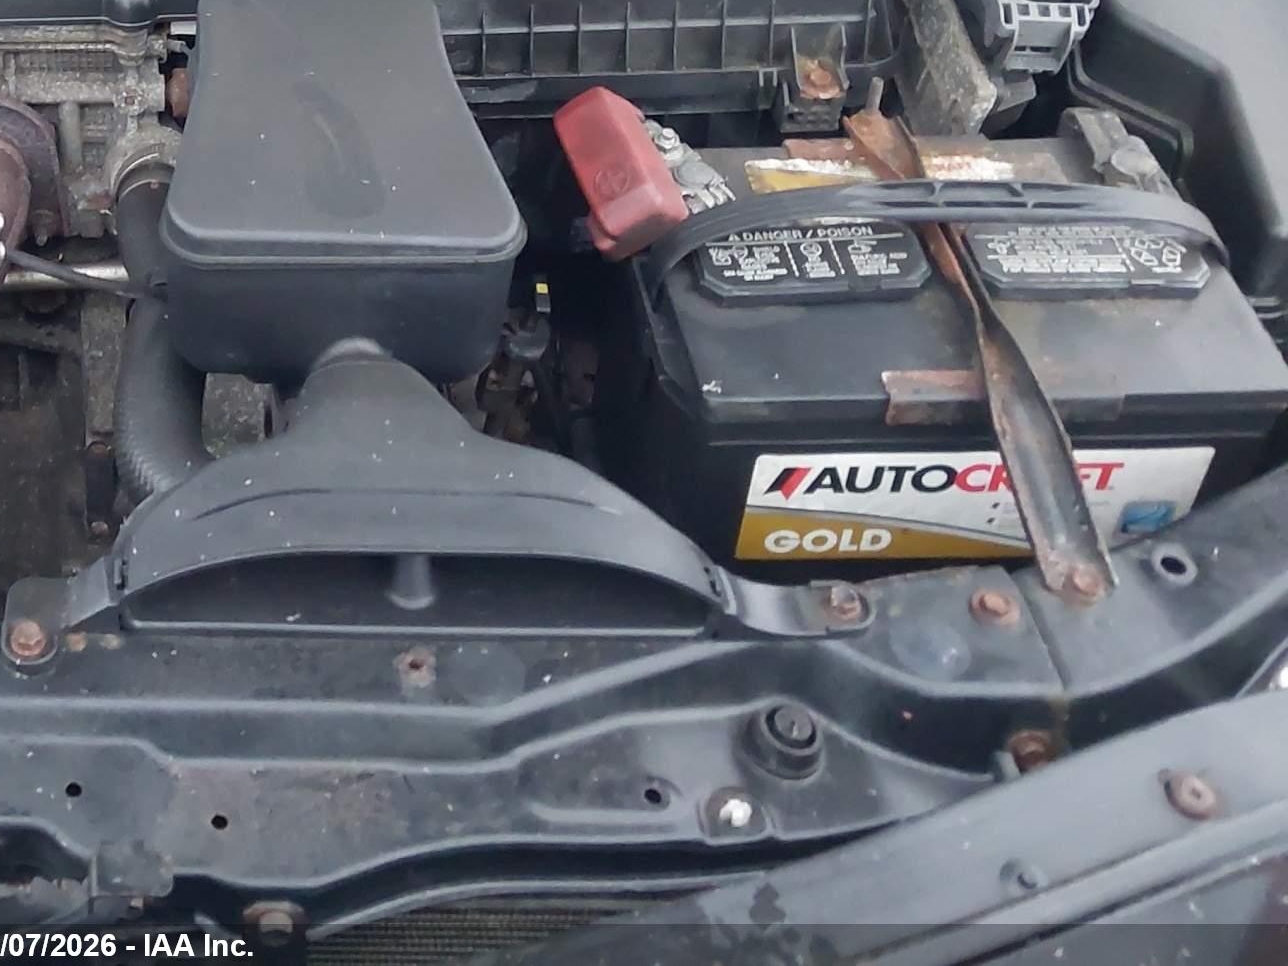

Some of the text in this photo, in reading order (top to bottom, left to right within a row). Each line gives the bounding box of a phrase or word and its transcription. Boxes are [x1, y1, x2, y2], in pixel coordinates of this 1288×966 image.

[745, 227, 803, 241] DANGER
[817, 225, 873, 239] POISON
[763, 528, 893, 554] GOLD
